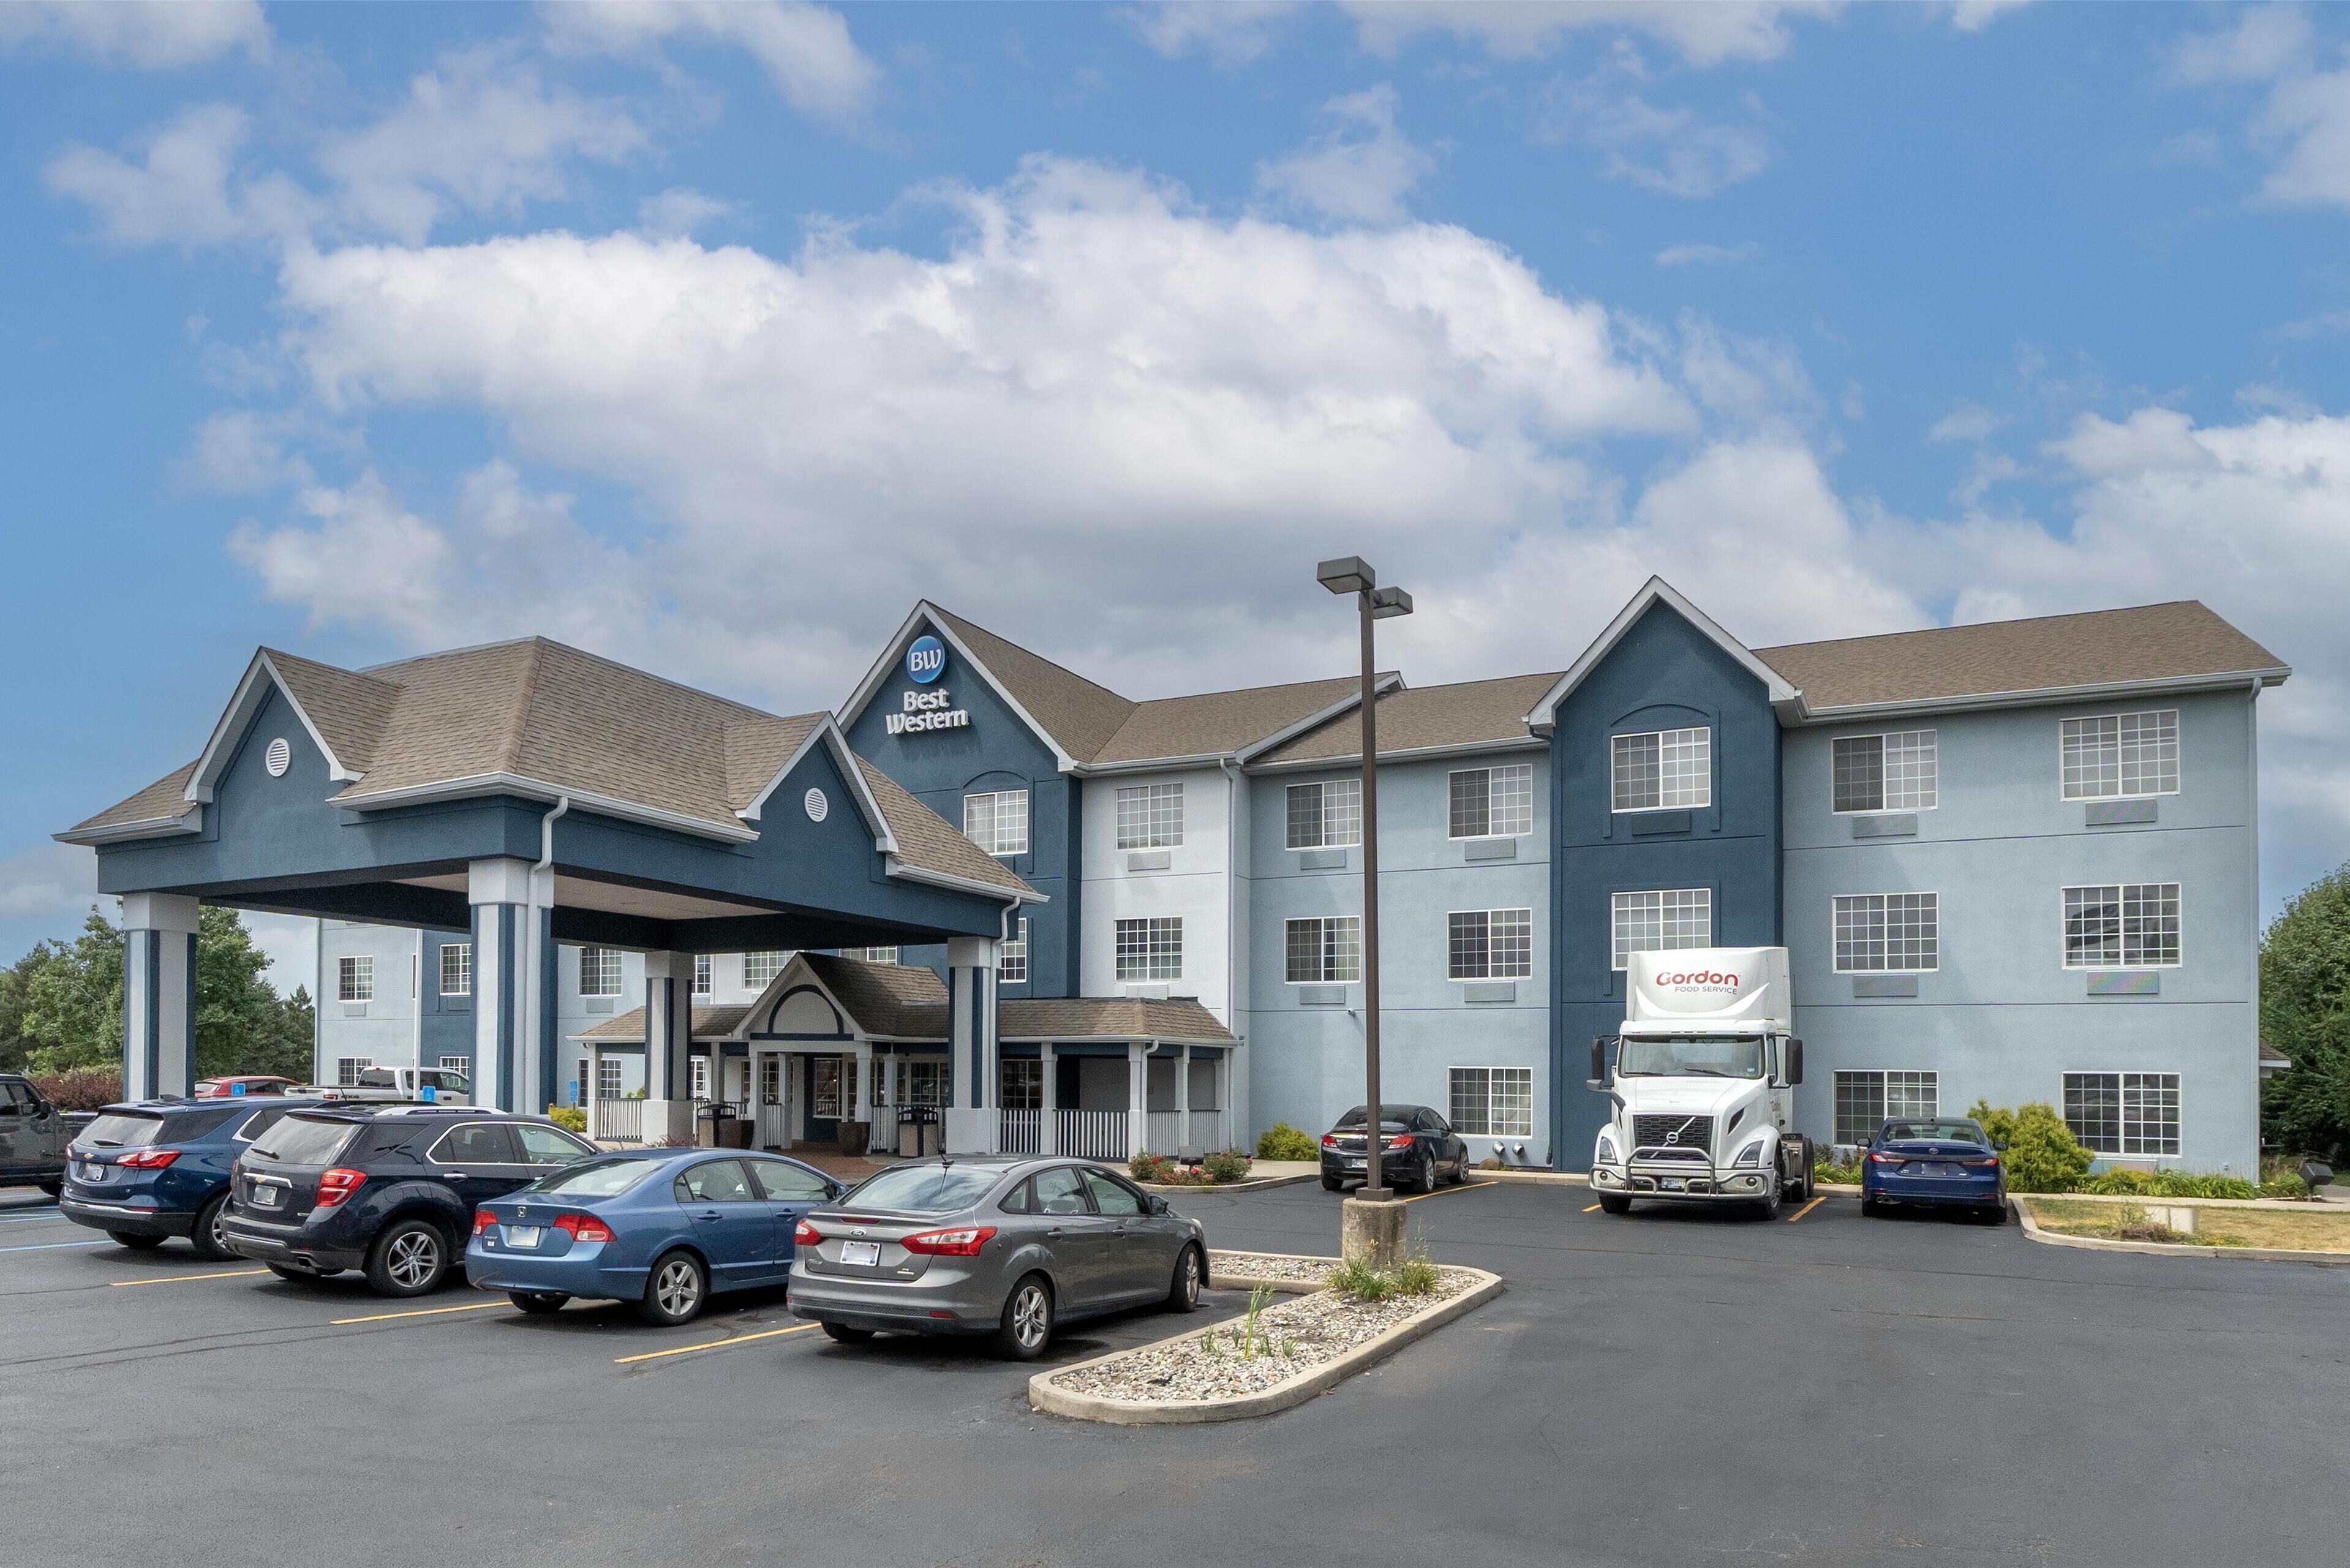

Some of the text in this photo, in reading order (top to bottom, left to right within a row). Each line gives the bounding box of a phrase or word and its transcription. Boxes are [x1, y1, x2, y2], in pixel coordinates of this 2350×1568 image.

[911, 649, 941, 672] BW
[903, 688, 950, 712] Best
[886, 709, 970, 735] Western
[1656, 970, 1739, 987] Gordon
[1701, 986, 1738, 995] SERVICE
